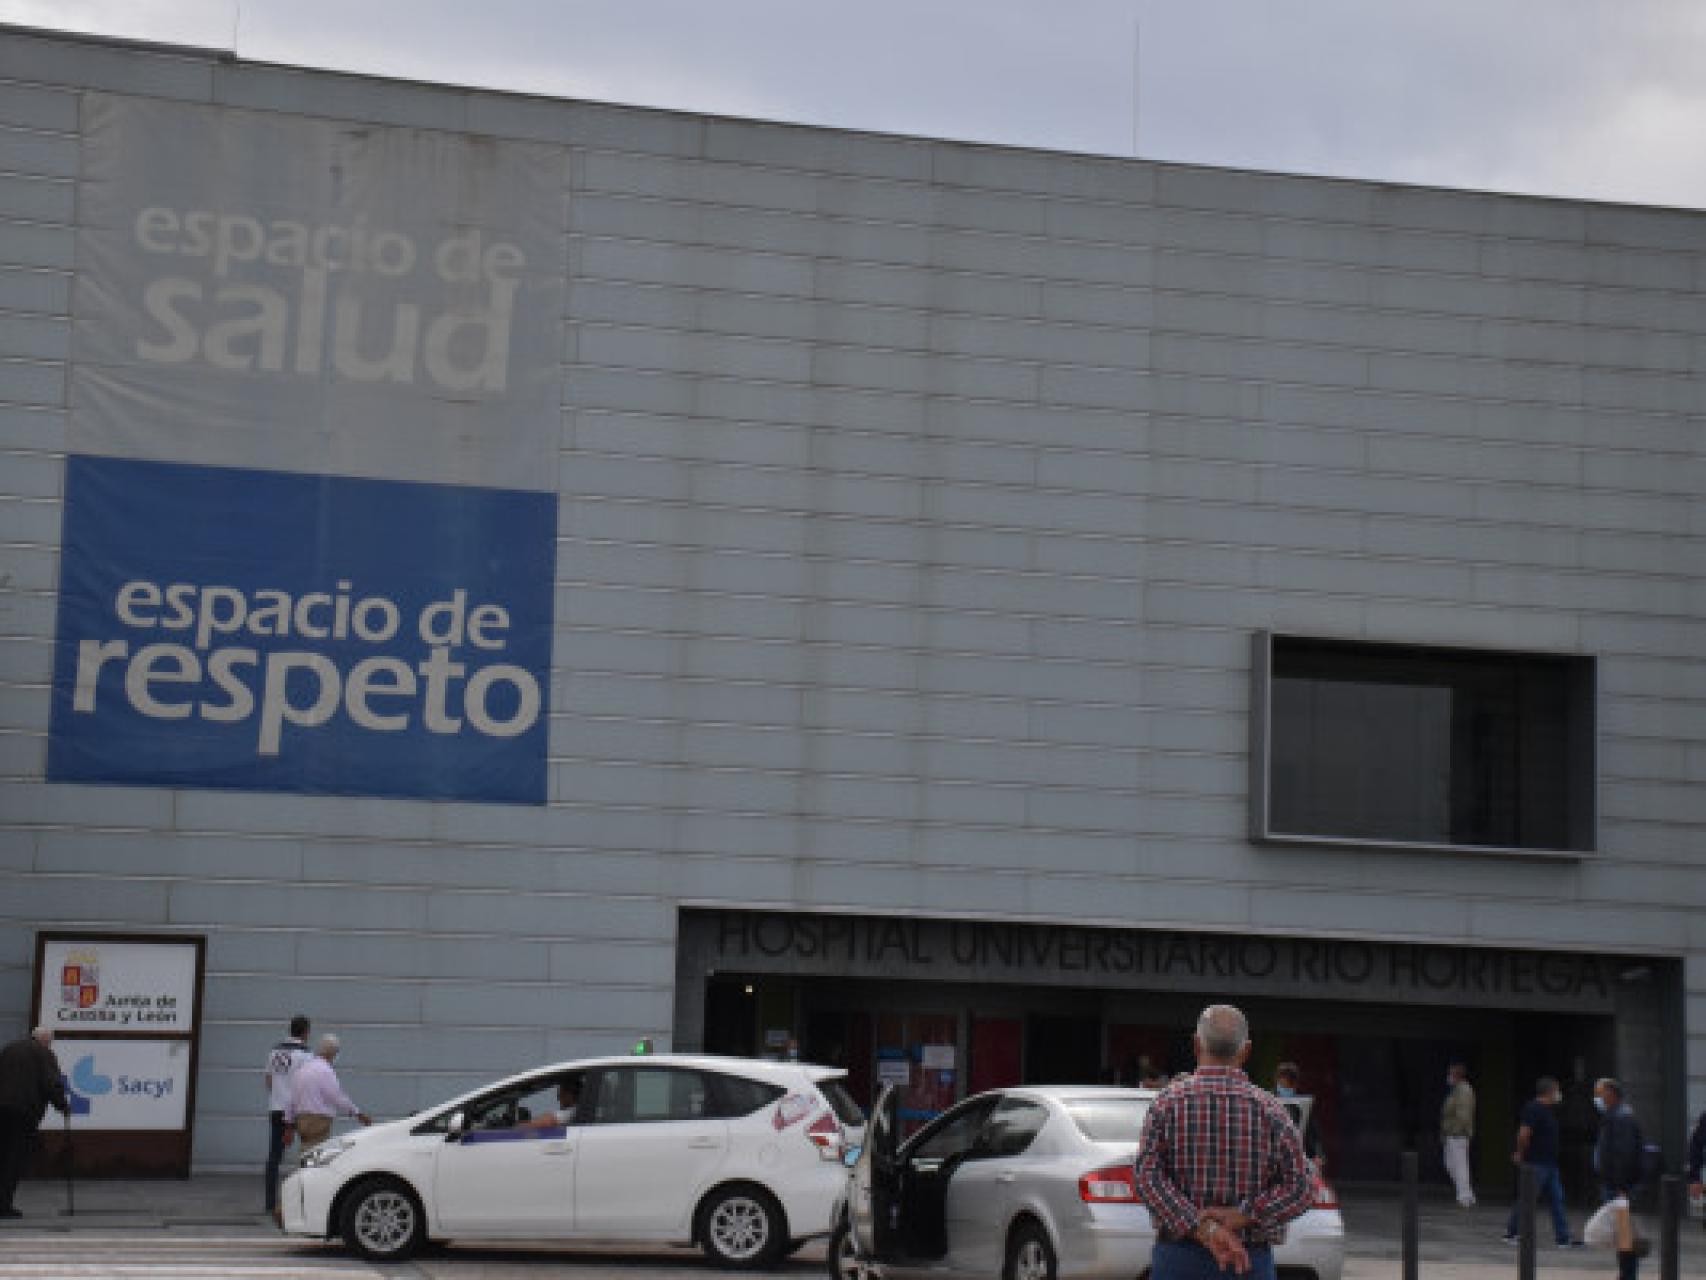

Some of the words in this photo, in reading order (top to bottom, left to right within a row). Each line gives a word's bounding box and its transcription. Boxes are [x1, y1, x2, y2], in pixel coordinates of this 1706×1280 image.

[136, 206, 417, 277] espacio
[433, 229, 527, 282] de
[136, 267, 520, 391] salud
[115, 579, 400, 648] espacio
[418, 588, 510, 649] de
[73, 639, 542, 756] respeto
[719, 912, 932, 963] HOSPITAL
[951, 924, 1277, 976] UNIVERSITARIO
[1389, 945, 1608, 997] HORTEGA
[119, 1010, 132, 1024] y
[156, 992, 177, 1008] de
[118, 1075, 173, 1098] Sacyl
